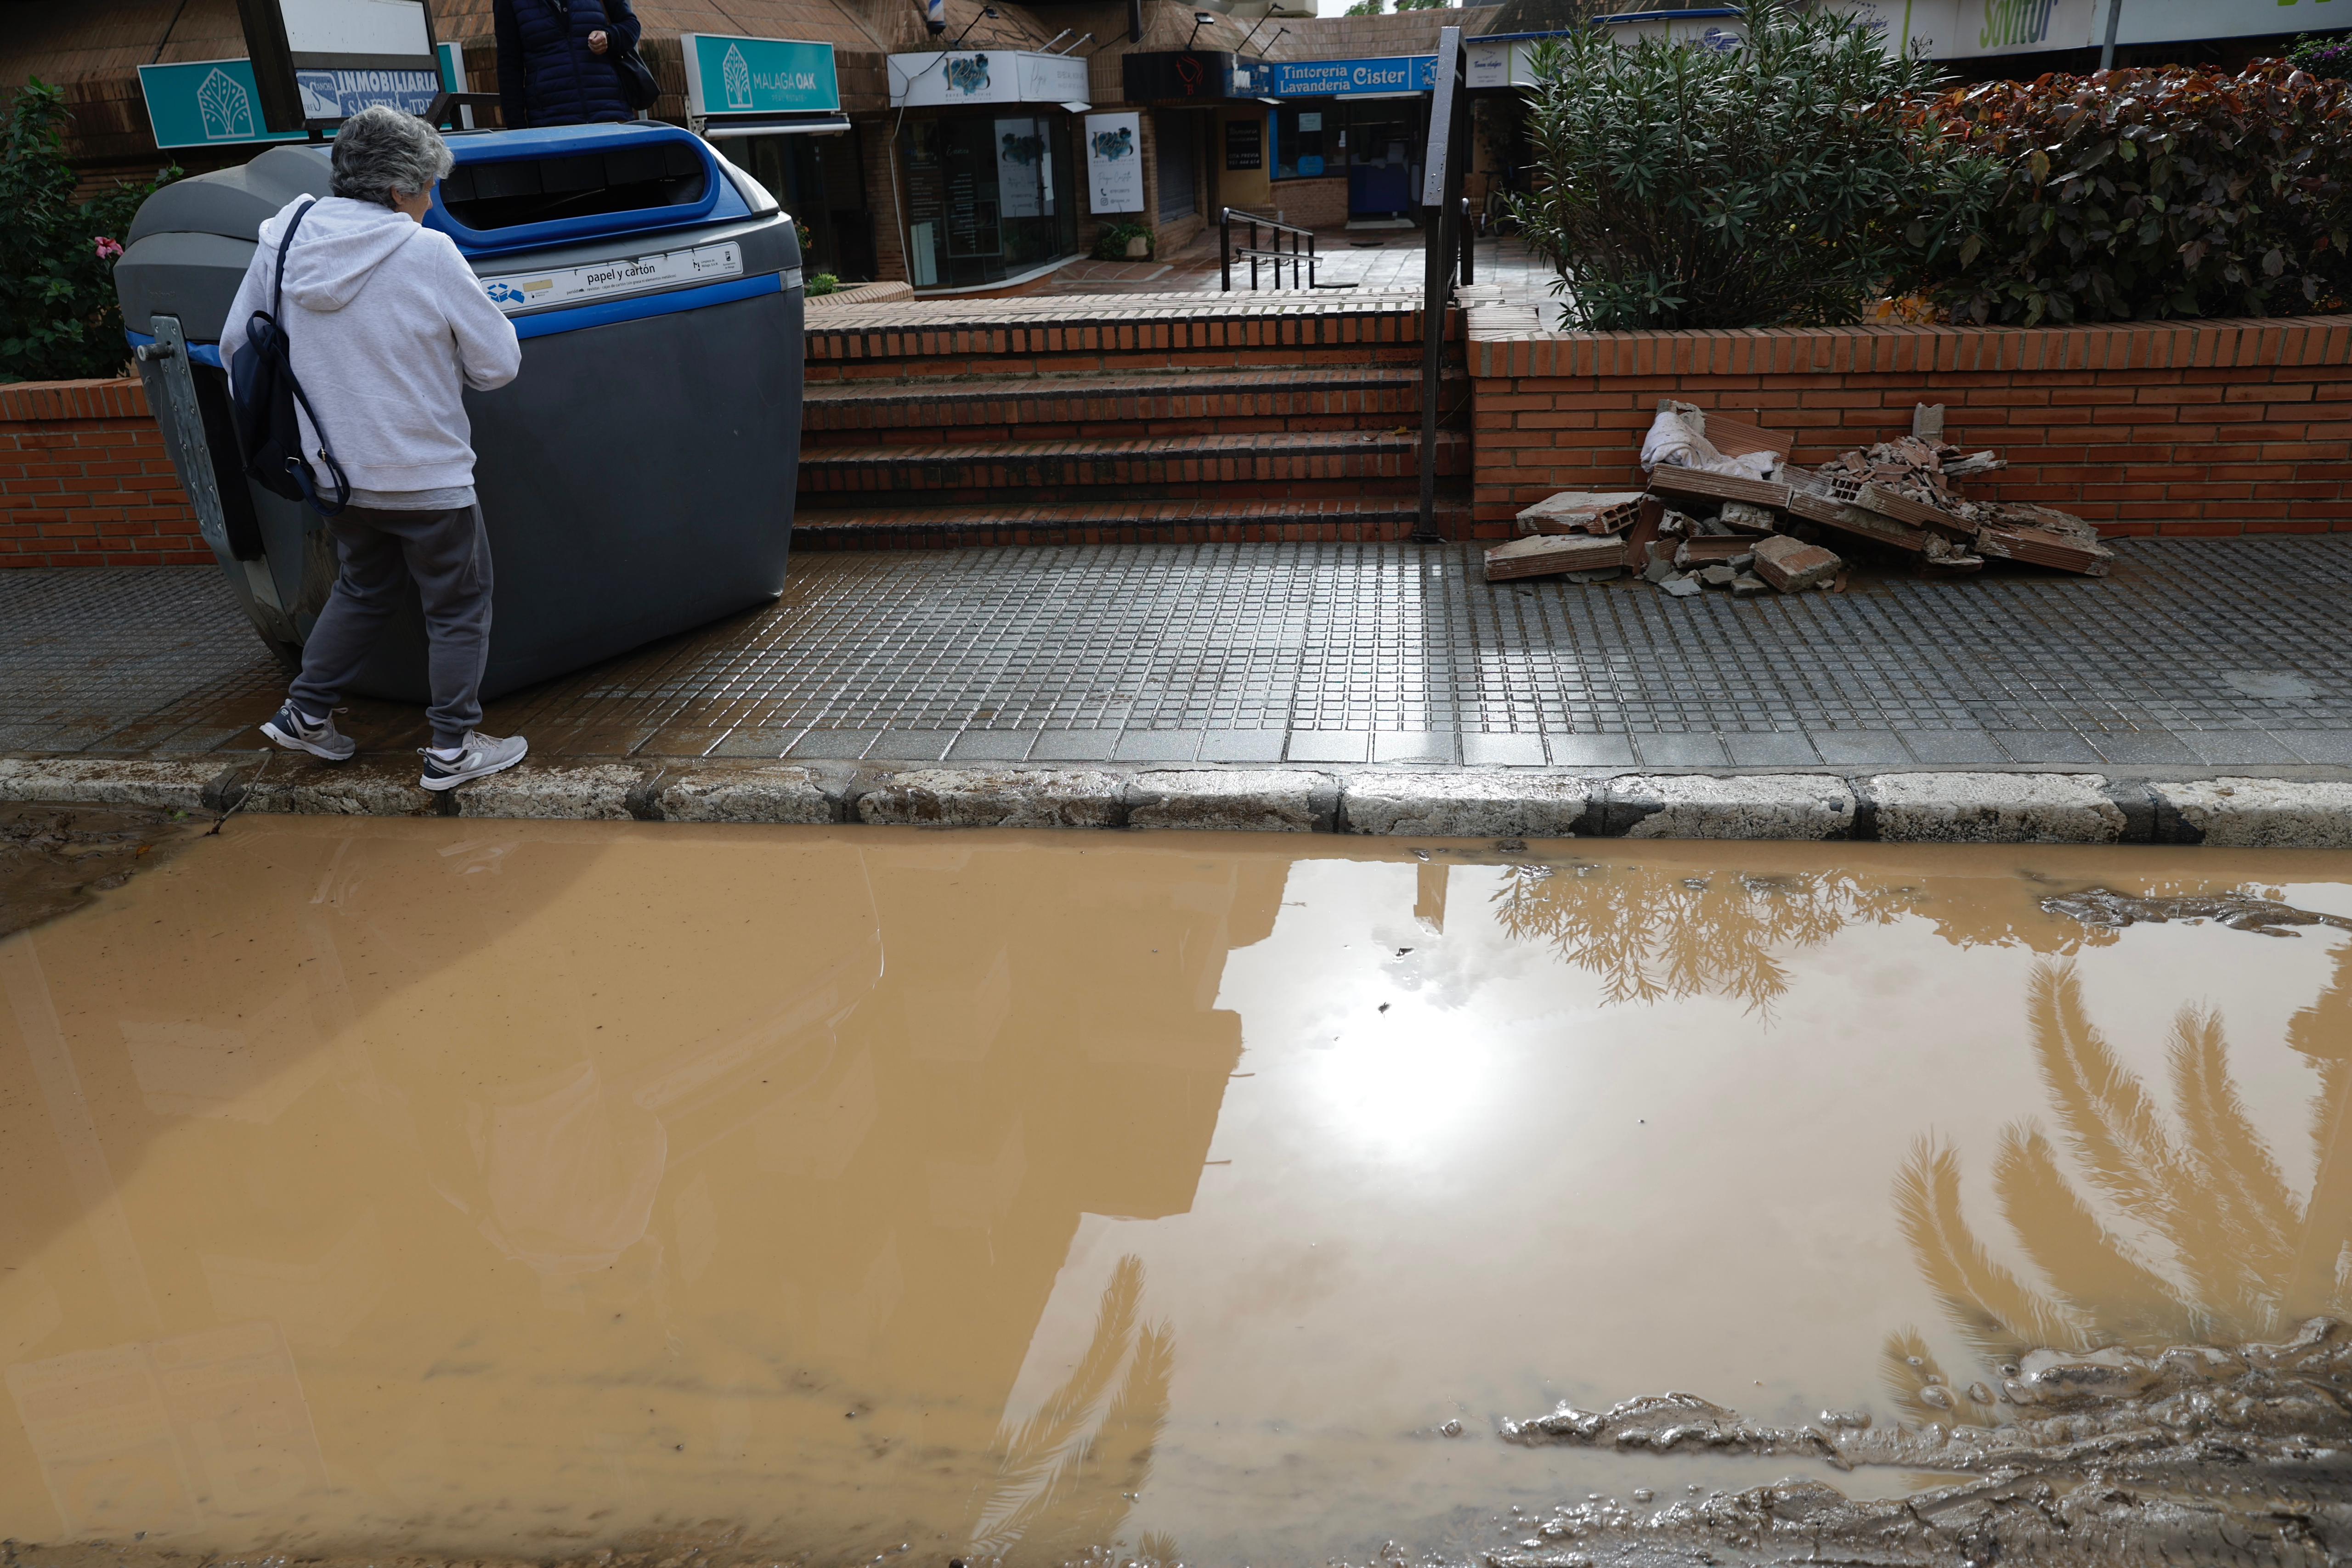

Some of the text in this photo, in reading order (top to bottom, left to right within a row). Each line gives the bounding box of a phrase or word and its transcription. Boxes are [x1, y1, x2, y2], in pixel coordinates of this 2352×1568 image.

[1282, 64, 1348, 79] Tintorería
[1353, 67, 1406, 85] Cister
[336, 71, 439, 94] INMOBILIARIA
[753, 72, 816, 90] MALAGA OAK
[1279, 79, 1351, 93] Lavandería
[587, 262, 656, 285] papel y cartón
